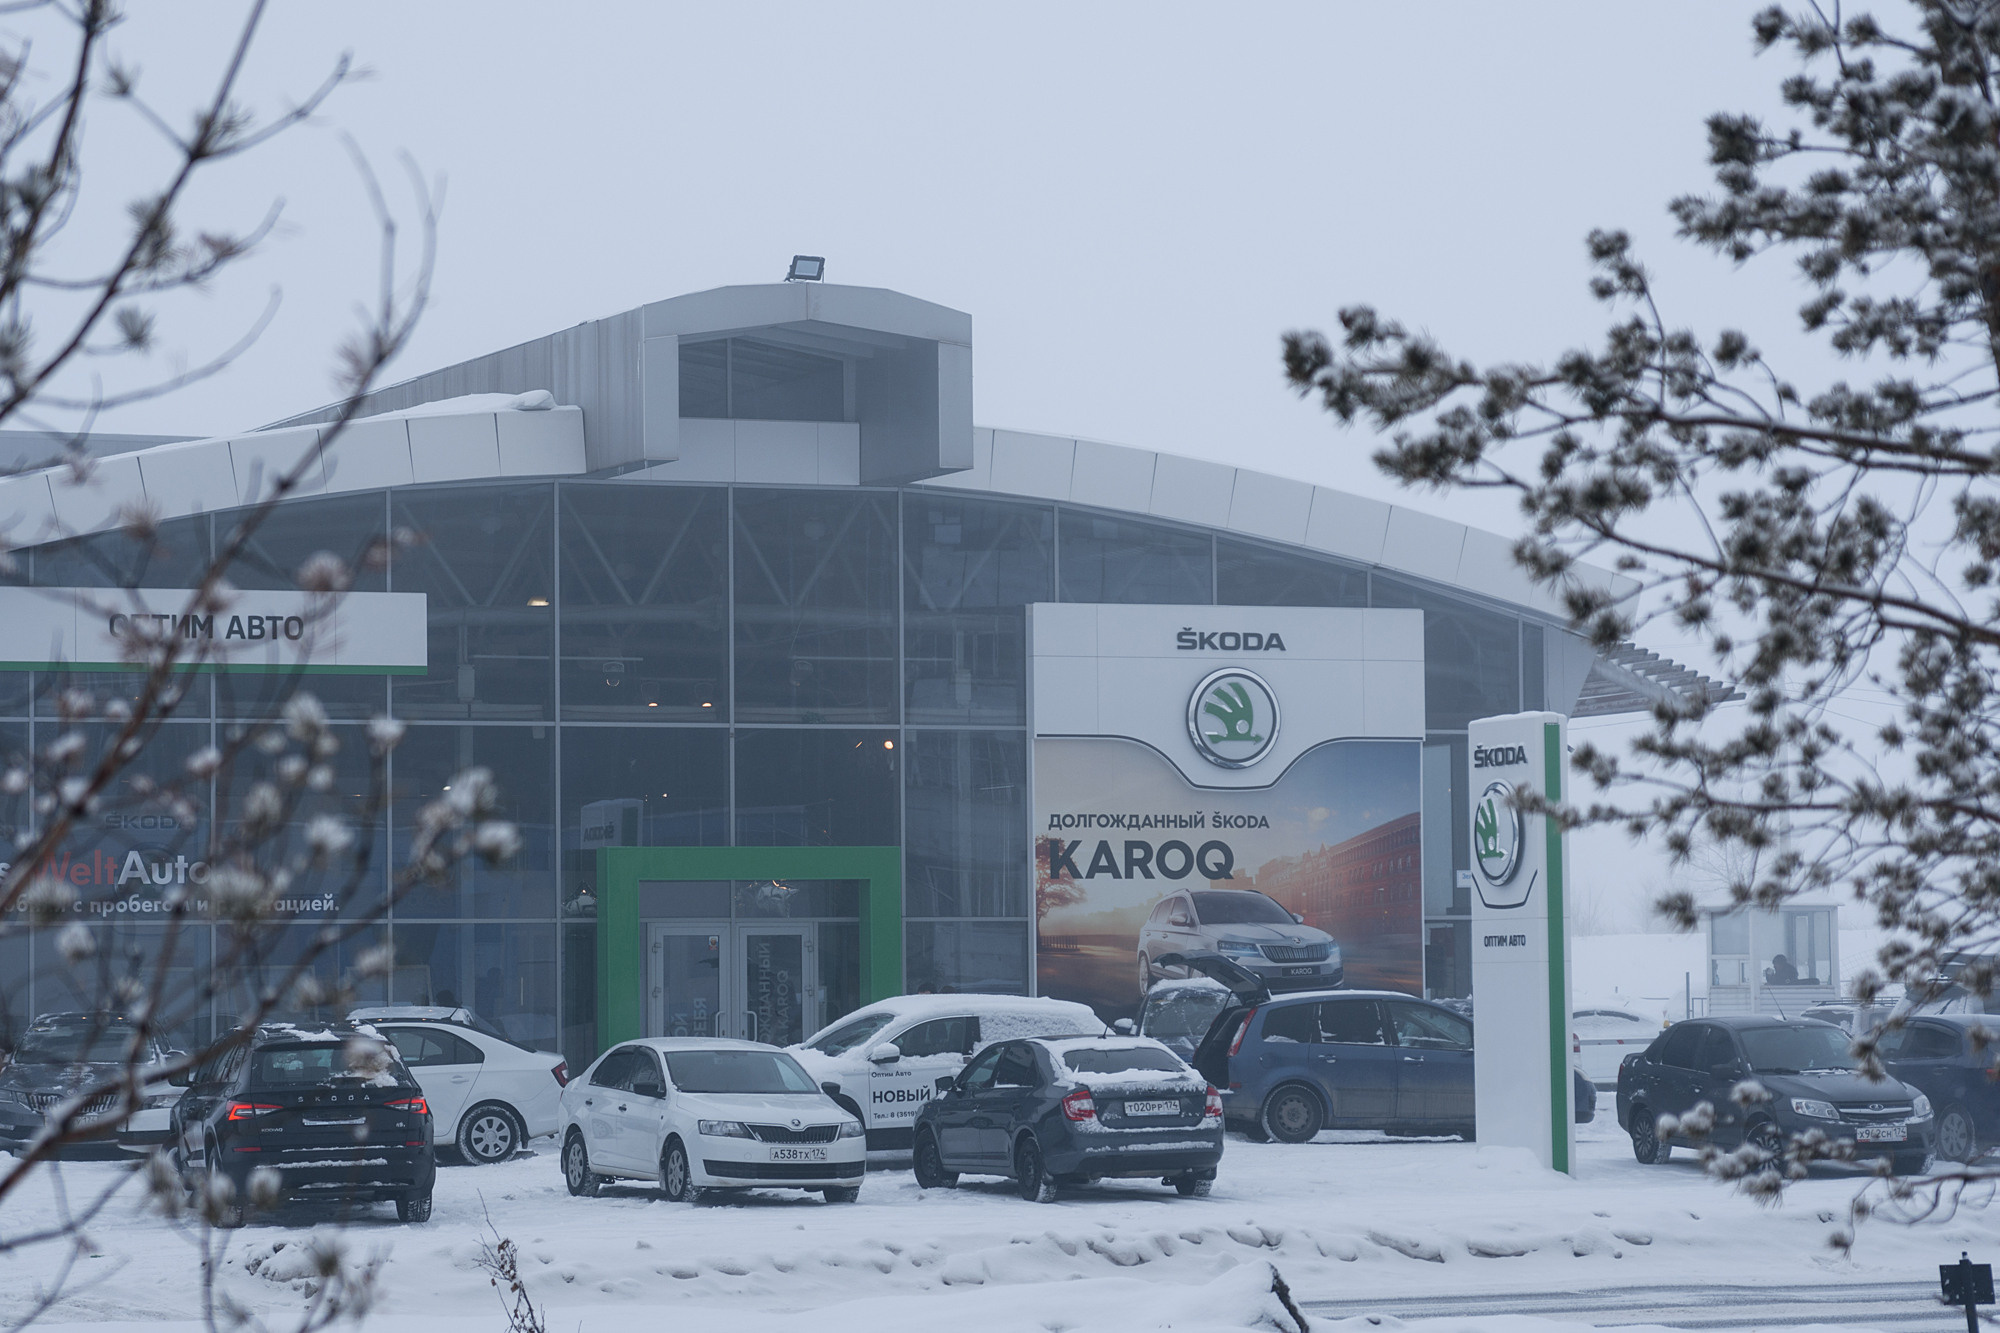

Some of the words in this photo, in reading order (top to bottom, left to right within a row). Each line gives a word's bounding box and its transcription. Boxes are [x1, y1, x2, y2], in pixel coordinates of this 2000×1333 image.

[225, 614, 305, 641] АВТО
[1176, 627, 1287, 651] ŠKODA
[1474, 744, 1528, 768] ŠKODA
[105, 811, 186, 830] ŠKOD
[1048, 811, 1205, 831] ДОЛГОЖДАННЫЙ
[1212, 811, 1270, 829] ŠKODA
[1049, 839, 1234, 880] KAROQ
[1484, 935, 1507, 947] ОПТИМ
[1509, 934, 1526, 946] АВТО
[1290, 967, 1313, 976] KAROQ
[872, 1085, 931, 1104] НОВЫЙ
